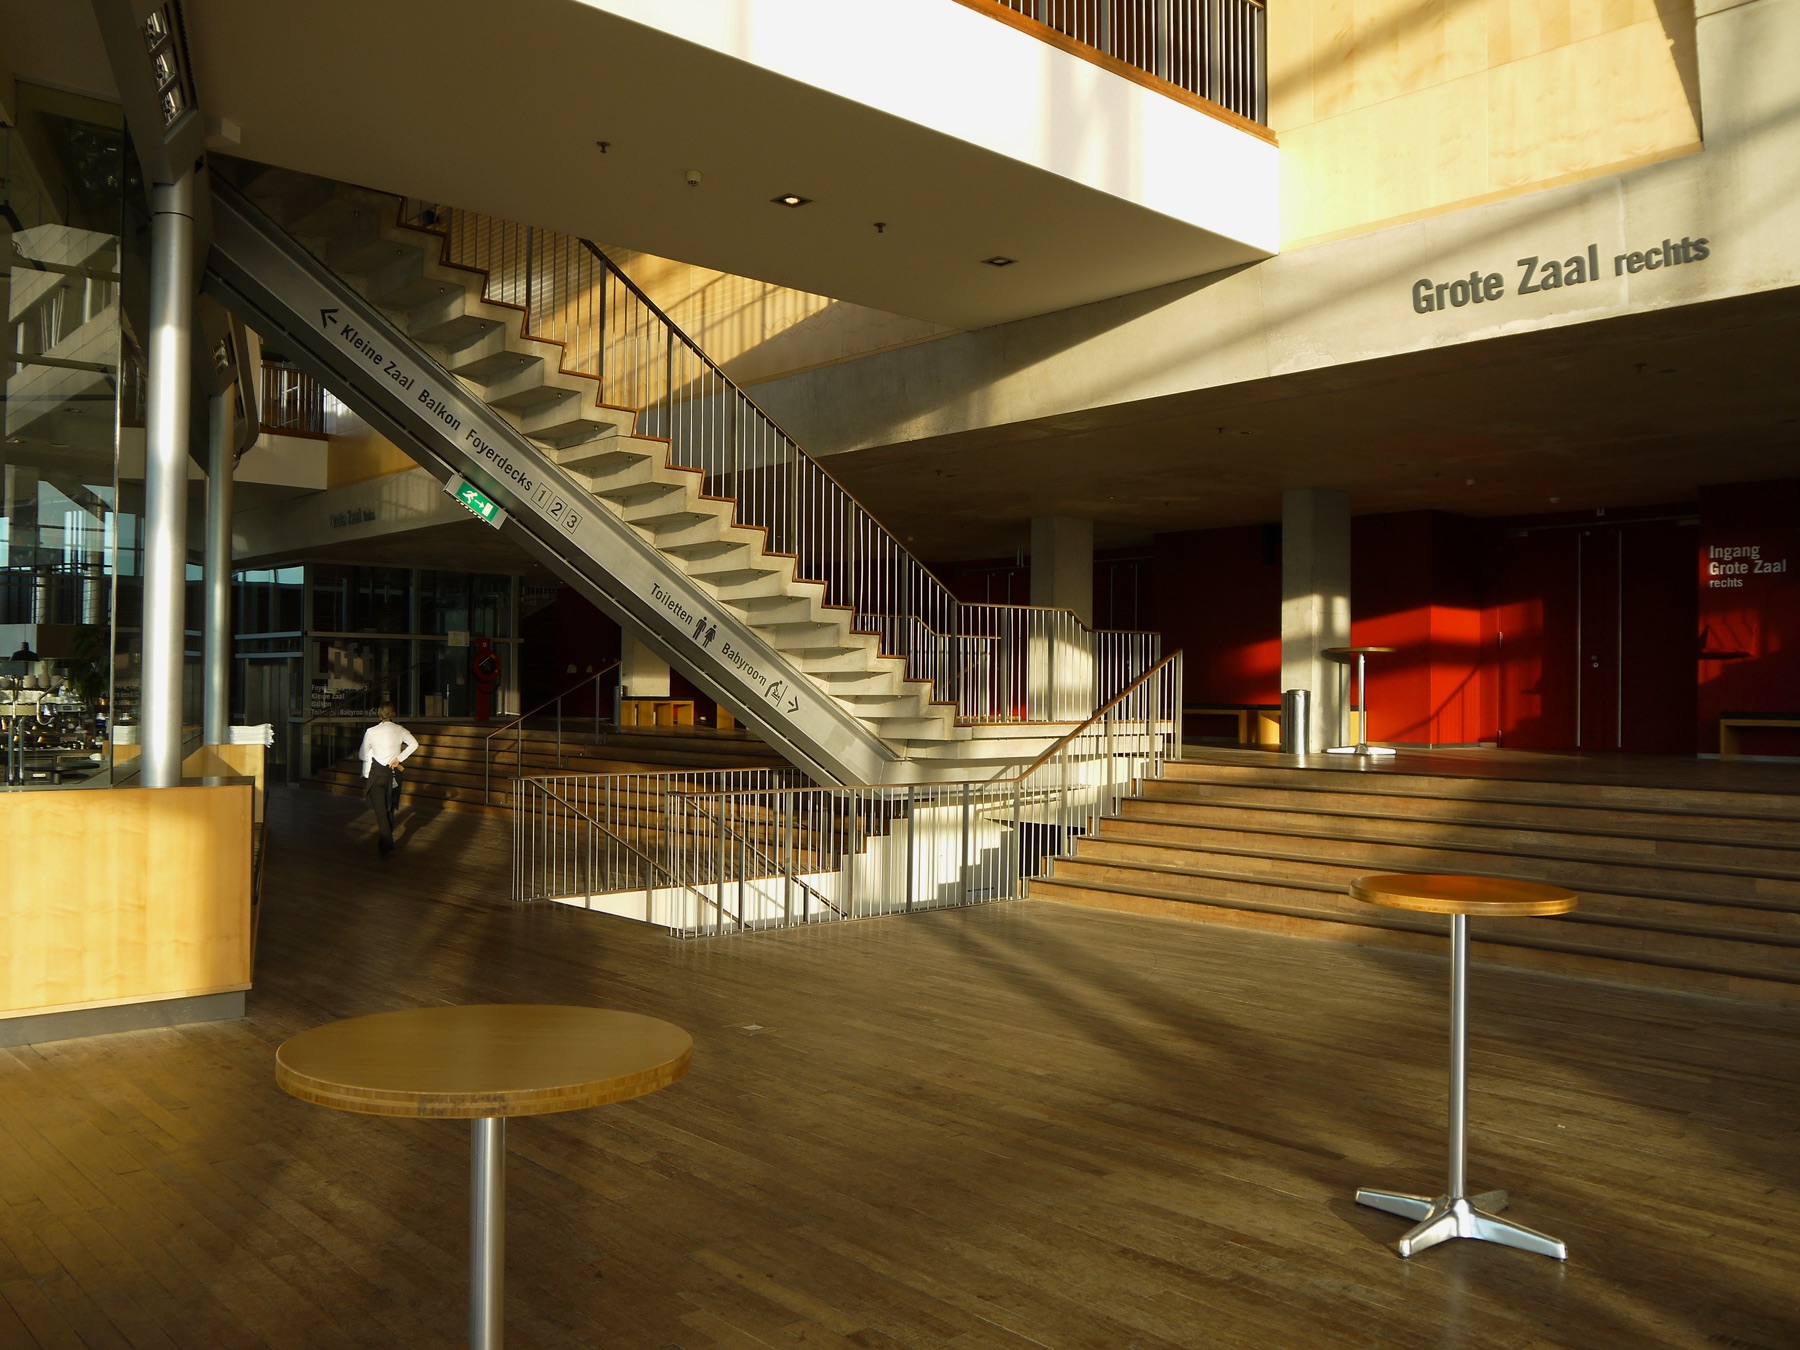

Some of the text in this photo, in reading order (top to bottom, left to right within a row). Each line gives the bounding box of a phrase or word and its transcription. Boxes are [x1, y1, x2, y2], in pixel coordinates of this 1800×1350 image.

[1412, 236, 1711, 315] Grote Zaal rechts
[340, 323, 415, 391] Kleine Zaal
[417, 388, 462, 431] Balkon
[465, 428, 534, 492] Foyerdecks
[1709, 545, 1760, 561] Ingang
[1709, 559, 1787, 576] Grote Zaal
[650, 582, 693, 626] Toiletten
[1709, 577, 1743, 588] rechts
[721, 642, 767, 687] Babyroom
